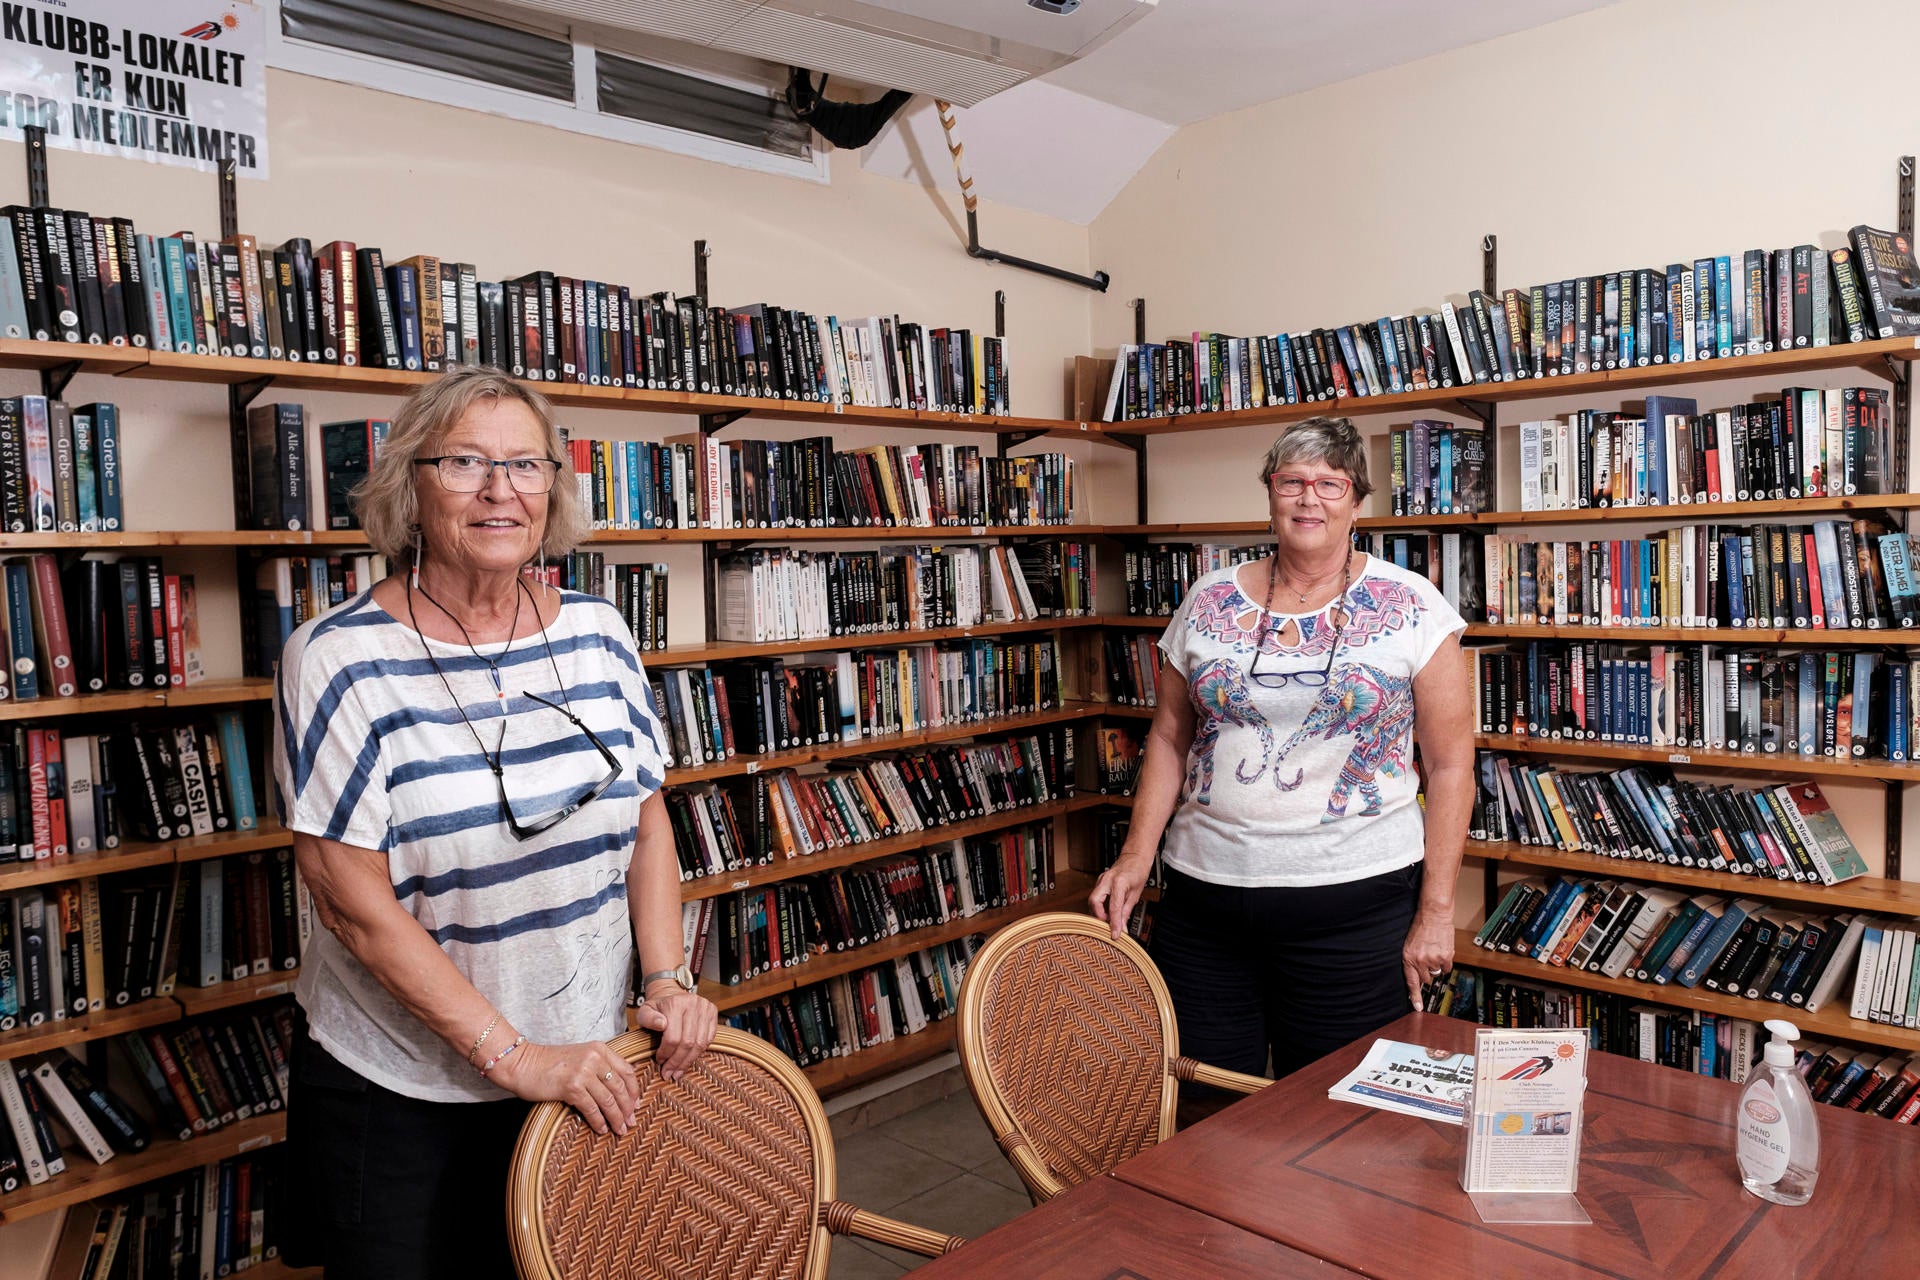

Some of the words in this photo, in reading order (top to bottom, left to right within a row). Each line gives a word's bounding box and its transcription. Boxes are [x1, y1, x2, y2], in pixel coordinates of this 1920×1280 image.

[2, 2, 245, 87] KLUBB-LOKALET
[75, 61, 112, 102] ER
[124, 71, 187, 117] KUN
[0, 90, 59, 136] FOR
[72, 102, 256, 168] MEDLEMMER
[54, 215, 66, 237] DAVID
[80, 218, 91, 241] DAVID
[104, 224, 115, 246] DAVID
[124, 225, 136, 247] DAVID
[1858, 233, 1867, 249] CLIVE
[57, 237, 72, 276] BALDACCI
[83, 241, 97, 278] BALDACCI
[423, 258, 436, 273] DAN
[1862, 249, 1875, 272] CUSSLER
[461, 273, 476, 297] DAN
[1640, 273, 1648, 288] CLIVE
[1683, 274, 1692, 293] CLIVE
[1699, 268, 1708, 289] CLIVE
[1751, 269, 1761, 295] CLIVE
[1797, 272, 1809, 295] ÅTE
[1836, 262, 1852, 288] CLIVE
[424, 274, 438, 302] BROWN
[442, 280, 455, 296] DAN
[1533, 289, 1542, 312] CLIVE
[1621, 278, 1631, 300] CLIVE
[1640, 287, 1648, 310] CUSSLER
[1671, 283, 1681, 305] CLIVE
[442, 296, 457, 324] BROWN
[525, 296, 539, 327] UGLEN
[1506, 292, 1517, 312] CLIVE
[1553, 303, 1561, 325] CLIVE
[1562, 300, 1570, 327] CUSSLER
[1579, 298, 1588, 323] CUSSLER
[1684, 294, 1693, 322] CUSSLER
[1700, 289, 1709, 321] CUSSLER
[1780, 275, 1788, 336] FILLEDOKKA
[1841, 287, 1861, 324] CUSSLER
[1874, 292, 1886, 313] MØRKET
[463, 299, 478, 339] BROWN
[1547, 299, 1555, 331] CUSSLER
[1621, 300, 1631, 334] CUSSLER
[1672, 306, 1682, 341] CUSSLER
[1752, 296, 1762, 337] CUSSLER
[1508, 312, 1521, 344] CUSSLER
[1533, 312, 1543, 347] CUSSLER
[1579, 329, 1587, 353] MEDUSA
[1829, 406, 1838, 427] DAHL
[1845, 405, 1856, 429] DAHL
[0, 414, 13, 464] STØRST
[77, 422, 88, 451] Grebe
[288, 430, 298, 451] Alle
[1393, 434, 1401, 451] CLIVE
[1467, 440, 1482, 451] CLIVE
[57, 437, 71, 479] Grebe
[103, 437, 115, 478] Grebe
[708, 443, 717, 460] JOY
[1463, 449, 1486, 461] CUSSLER
[5, 470, 15, 487] AV
[288, 472, 301, 498] alene
[708, 460, 719, 501] FIELDING
[7, 491, 18, 515] ALT
[1772, 532, 1783, 564] JOHNSRUD
[1790, 532, 1803, 564] JOHNSRUD
[1890, 540, 1903, 565] PETER
[1729, 550, 1737, 583] JOHNSTON
[1894, 566, 1909, 592] JAMES
[1846, 559, 1860, 616] NORDSTJERNEN
[1549, 662, 1557, 680] BILLY
[1550, 682, 1558, 716] STRAIGHT
[1825, 708, 1835, 745] AVSLØRT
[185, 764, 208, 815] CASH
[1782, 795, 1801, 824] Mikael
[1796, 820, 1813, 846] Niemi
[1820, 836, 1850, 855] Niemi
[89, 881, 98, 915] PETER
[92, 919, 101, 955] MAYLE
[1739, 1028, 1748, 1050] BECKS
[1738, 1051, 1747, 1071] SISTE
[1367, 1074, 1439, 1094] NATT
[1388, 1062, 1474, 1086] ngstedt
[1830, 1081, 1848, 1101] WILSON
[1876, 1094, 1895, 1113] WILSON
[1740, 1128, 1769, 1147] HYGIENE
[1769, 1142, 1786, 1154] GEL
[1750, 1124, 1771, 1139] HAND
